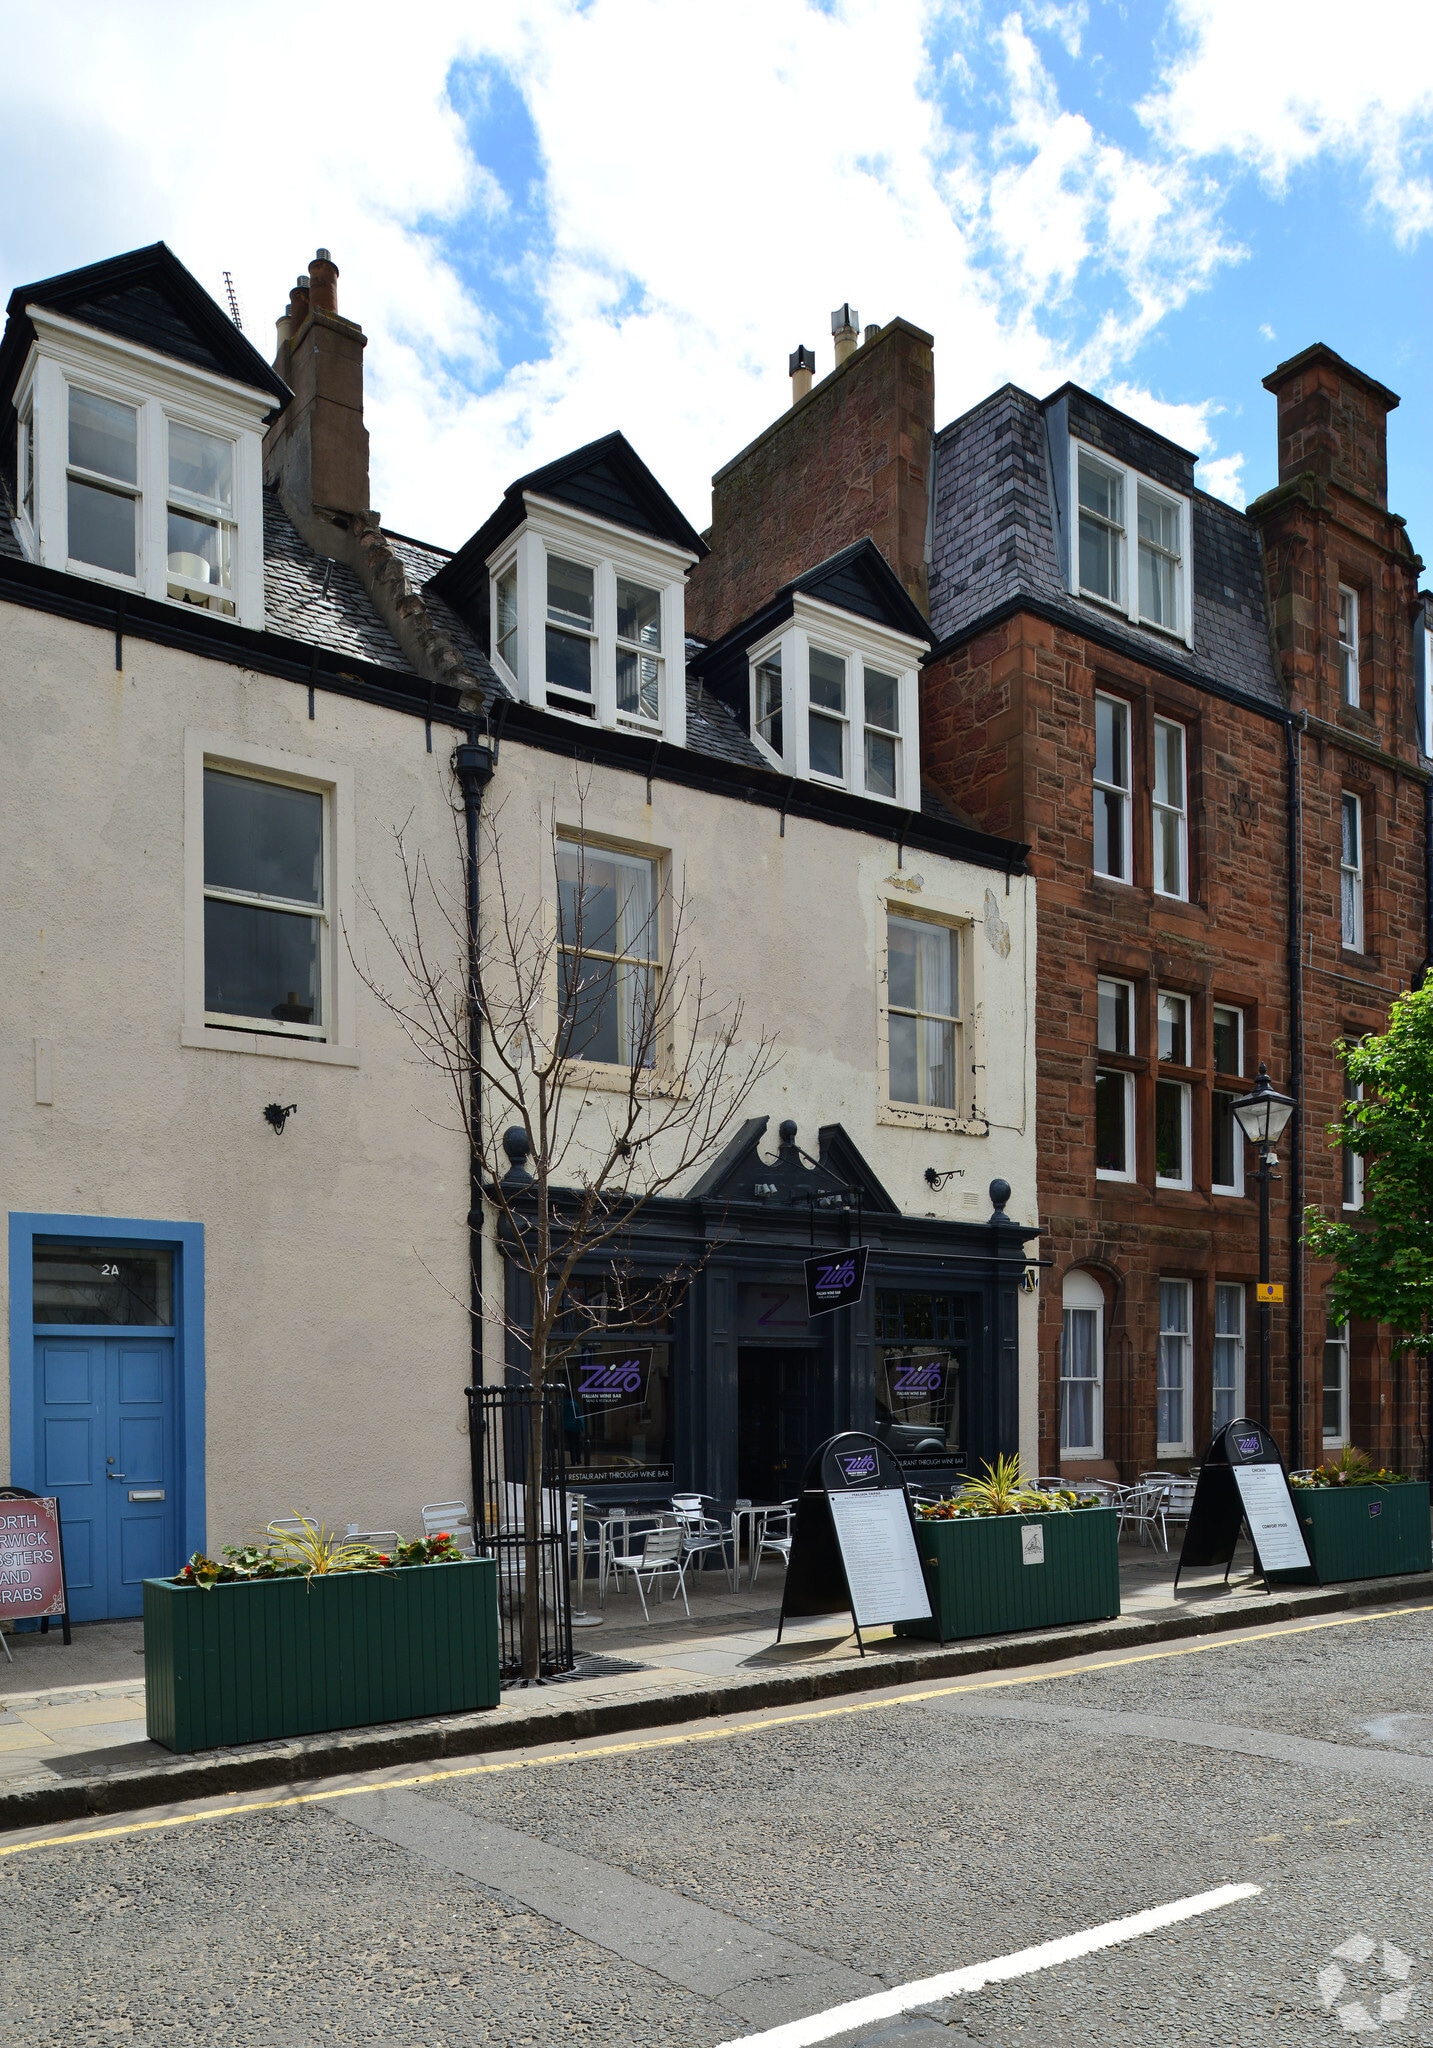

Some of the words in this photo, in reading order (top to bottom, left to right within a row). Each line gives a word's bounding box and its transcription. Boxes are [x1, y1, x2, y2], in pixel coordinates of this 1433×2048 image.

[102, 1264, 119, 1275] 2A
[815, 1259, 855, 1289] Zitto
[578, 1360, 641, 1393] Zitto
[893, 1362, 941, 1390] Zitto
[1238, 1436, 1260, 1451] Zitto
[844, 1454, 876, 1472] Zitto
[918, 1458, 940, 1466] THROUGH
[568, 1472, 608, 1481] RESTAURANT
[609, 1471, 639, 1479] THROUGH
[0, 1514, 38, 1530] ORTH
[0, 1531, 48, 1549] RWICK
[0, 1570, 31, 1585] AND
[0, 1587, 43, 1604] RABS
